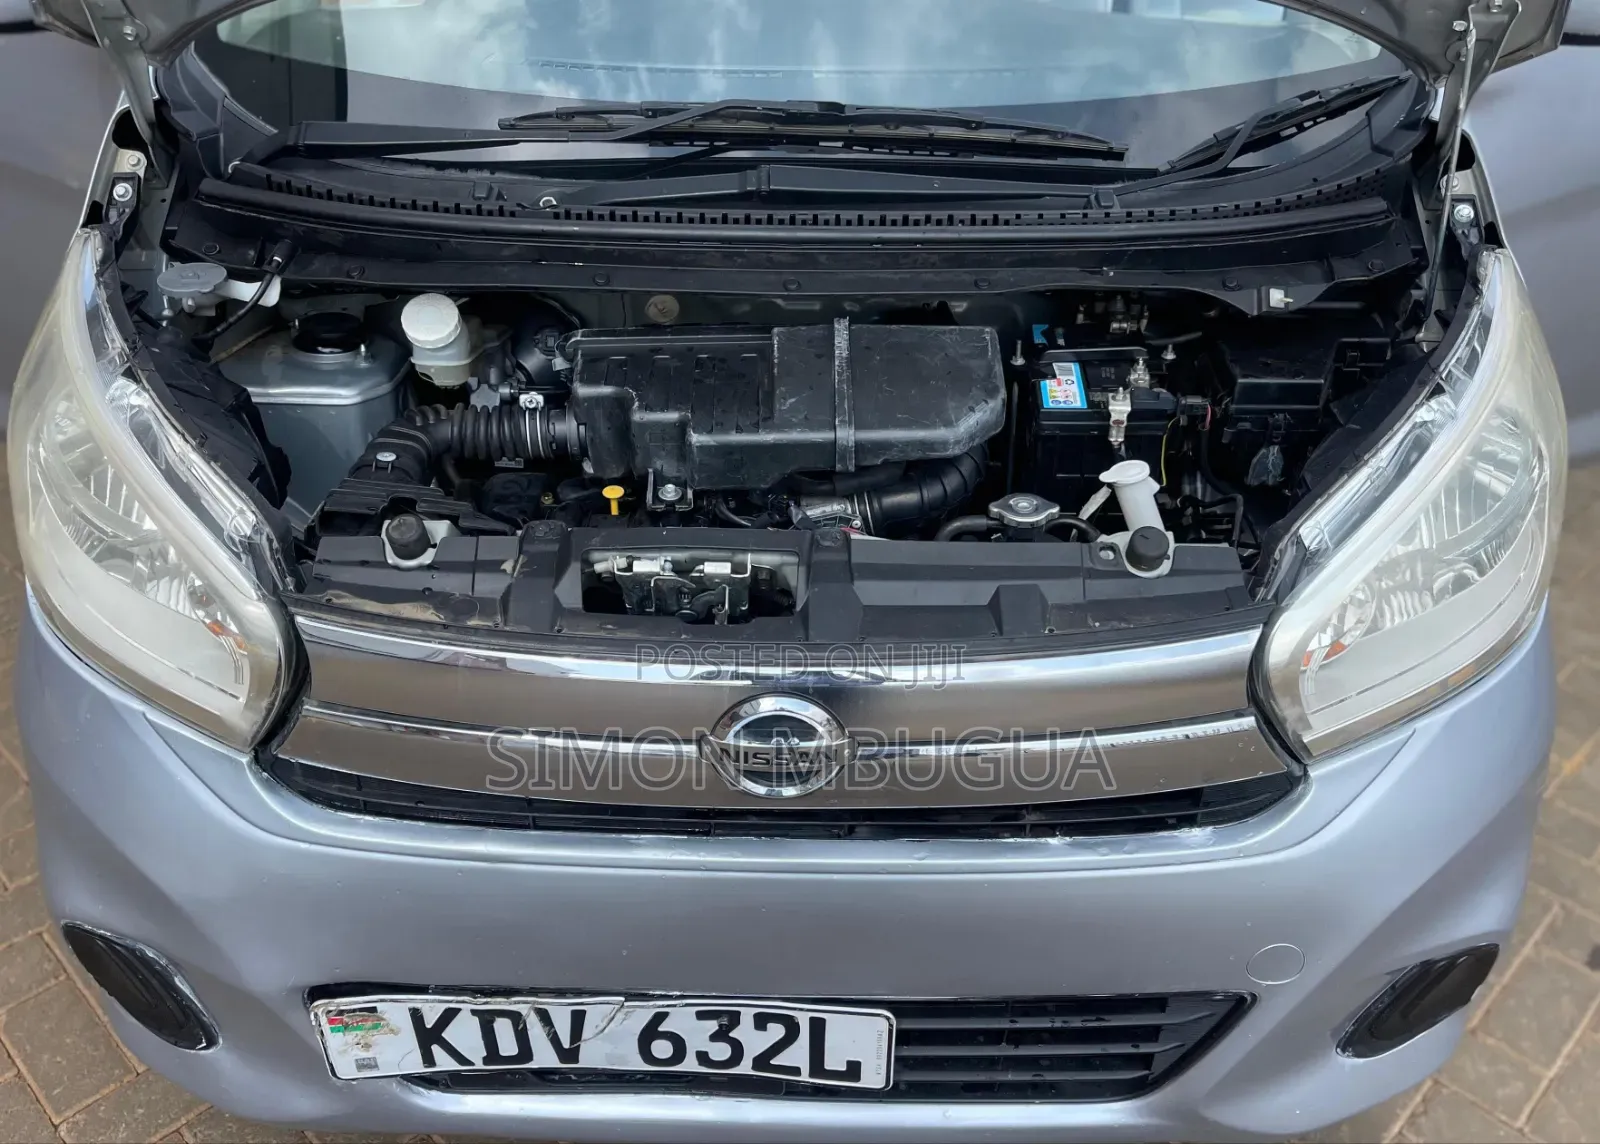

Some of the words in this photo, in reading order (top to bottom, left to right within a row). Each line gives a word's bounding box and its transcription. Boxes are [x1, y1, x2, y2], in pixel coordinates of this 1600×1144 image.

[719, 747, 838, 766] NISSAN
[407, 1006, 588, 1068] KDV
[637, 1009, 862, 1083] 632L
